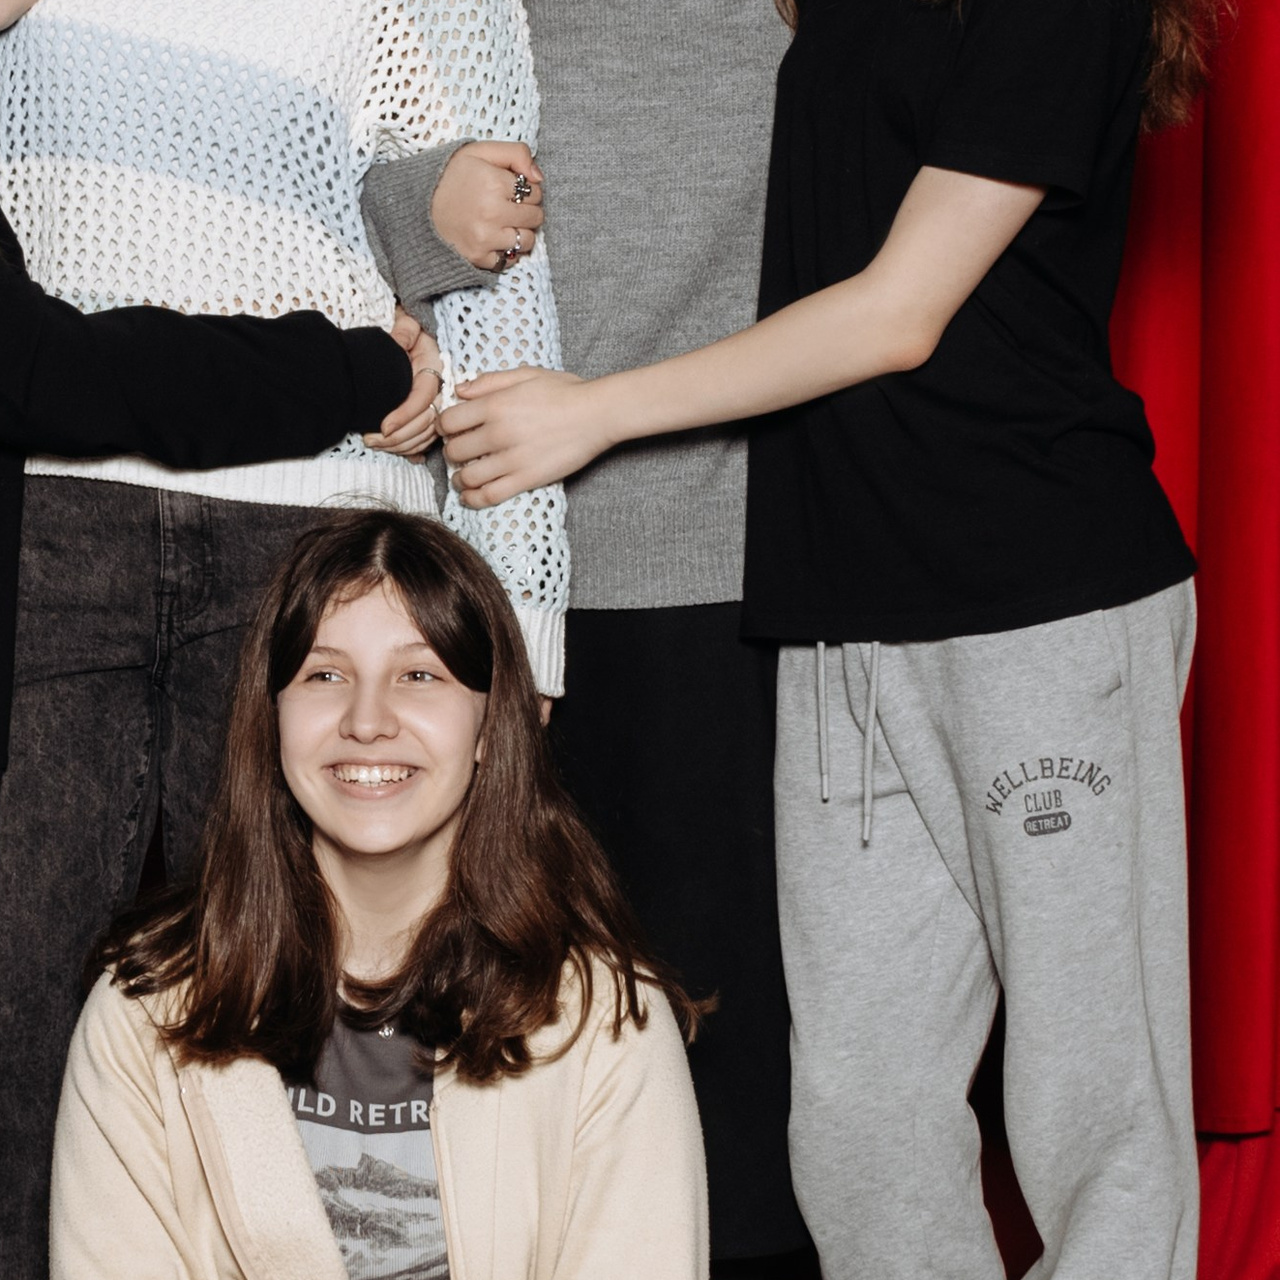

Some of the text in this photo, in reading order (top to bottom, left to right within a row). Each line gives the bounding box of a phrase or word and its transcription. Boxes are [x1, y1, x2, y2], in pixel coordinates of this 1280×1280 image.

[985, 757, 1111, 816] WELLBEING
[1024, 789, 1063, 813] CLUB
[1025, 814, 1070, 833] RETREAT
[349, 1099, 430, 1127] RETR
